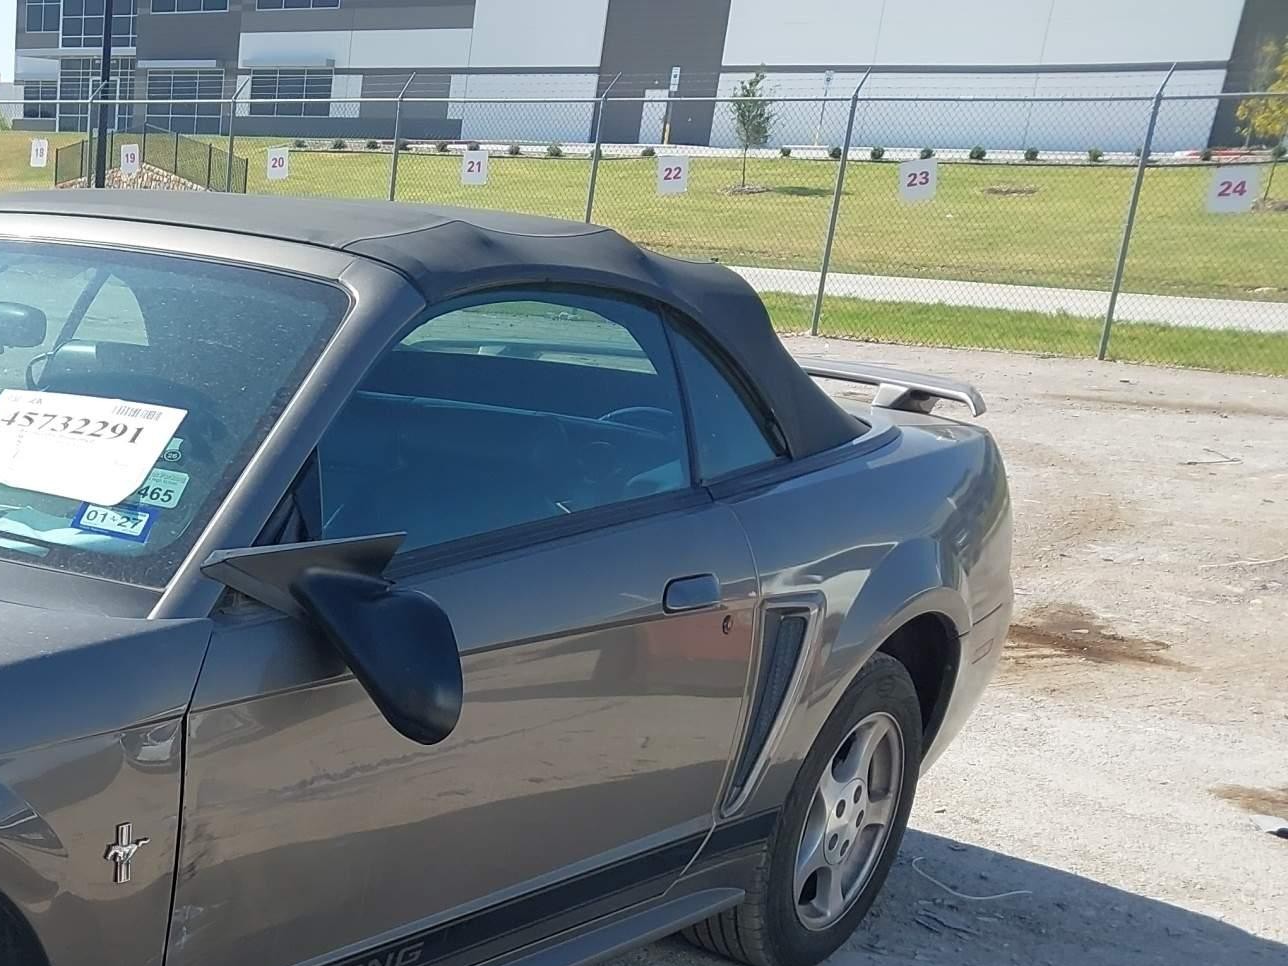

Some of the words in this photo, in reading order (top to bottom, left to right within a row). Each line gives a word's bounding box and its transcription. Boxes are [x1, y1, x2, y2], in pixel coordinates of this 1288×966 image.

[125, 152, 136, 163] 19
[271, 156, 285, 168] 20
[467, 160, 482, 173] 21
[663, 166, 682, 181] 22
[906, 170, 930, 188] 23
[1217, 180, 1247, 197] 24
[0, 409, 145, 445] 45732291
